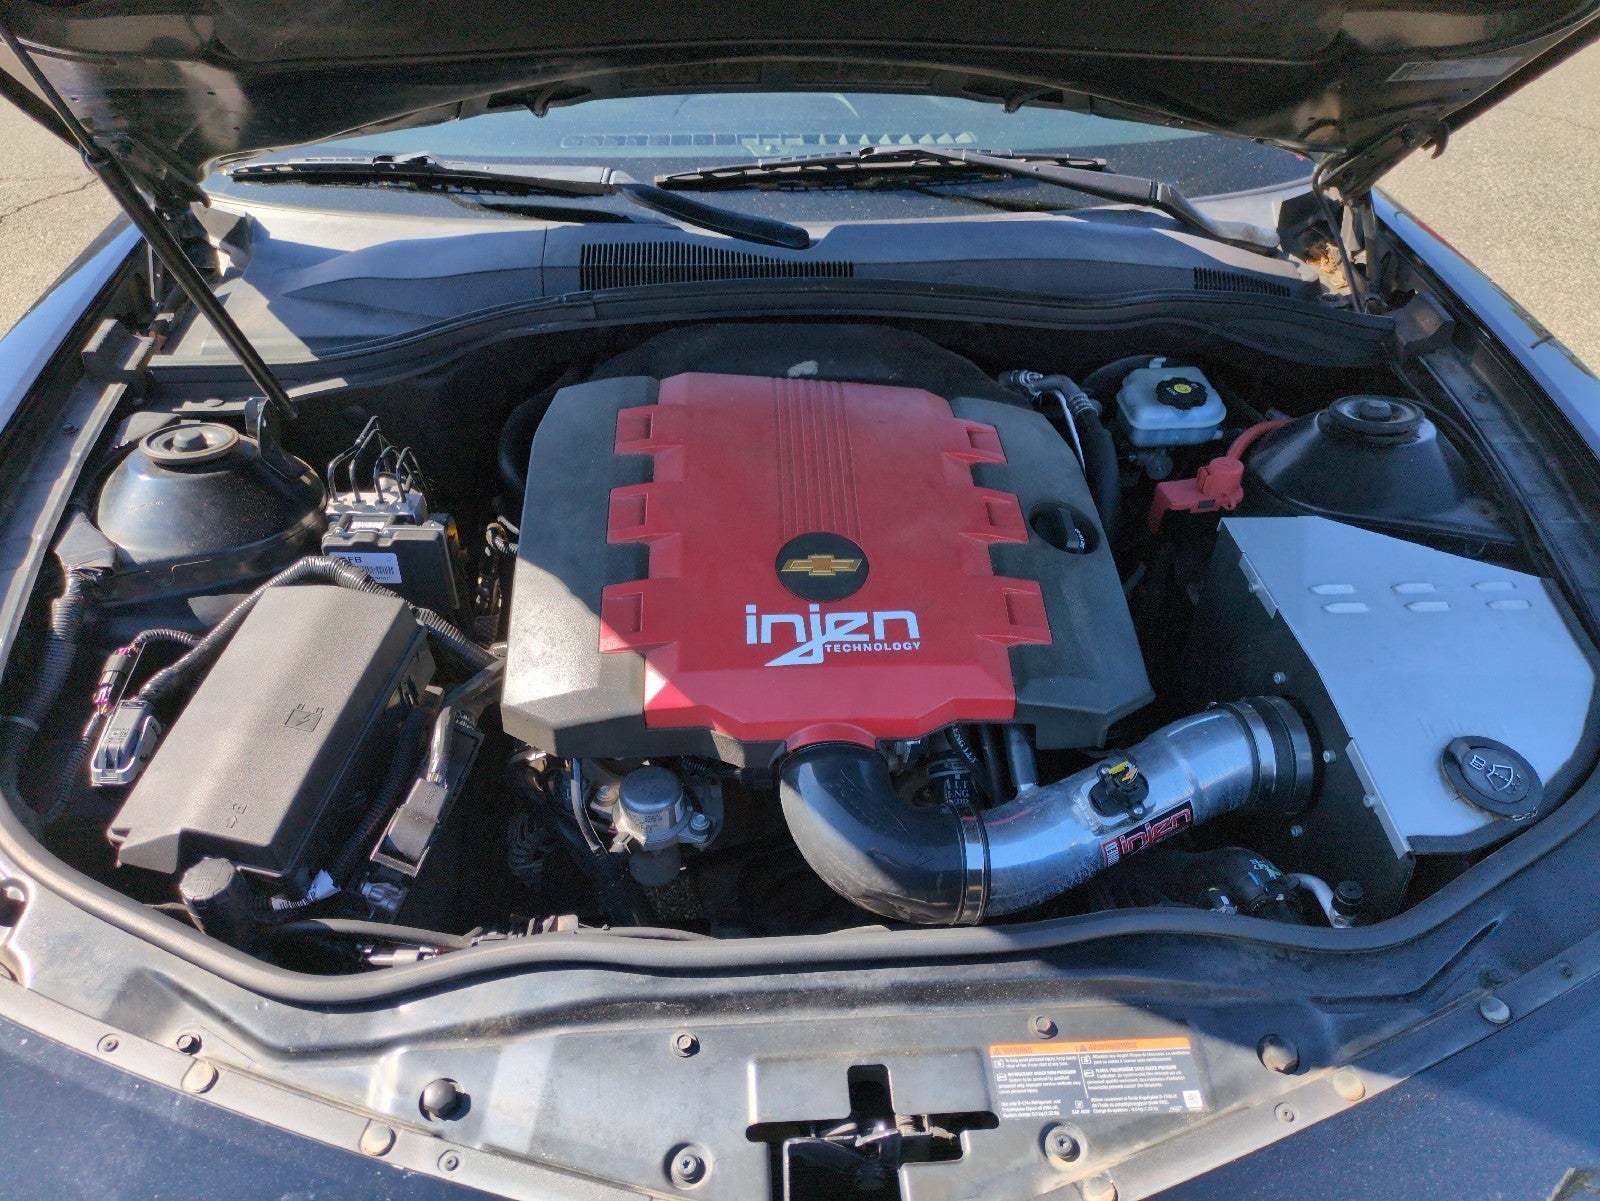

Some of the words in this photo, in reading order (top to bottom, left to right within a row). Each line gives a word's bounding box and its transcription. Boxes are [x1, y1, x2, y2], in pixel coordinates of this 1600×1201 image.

[745, 603, 921, 667] injen
[825, 642, 921, 653] TECHNOLOGY
[1119, 808, 1192, 856] injen
